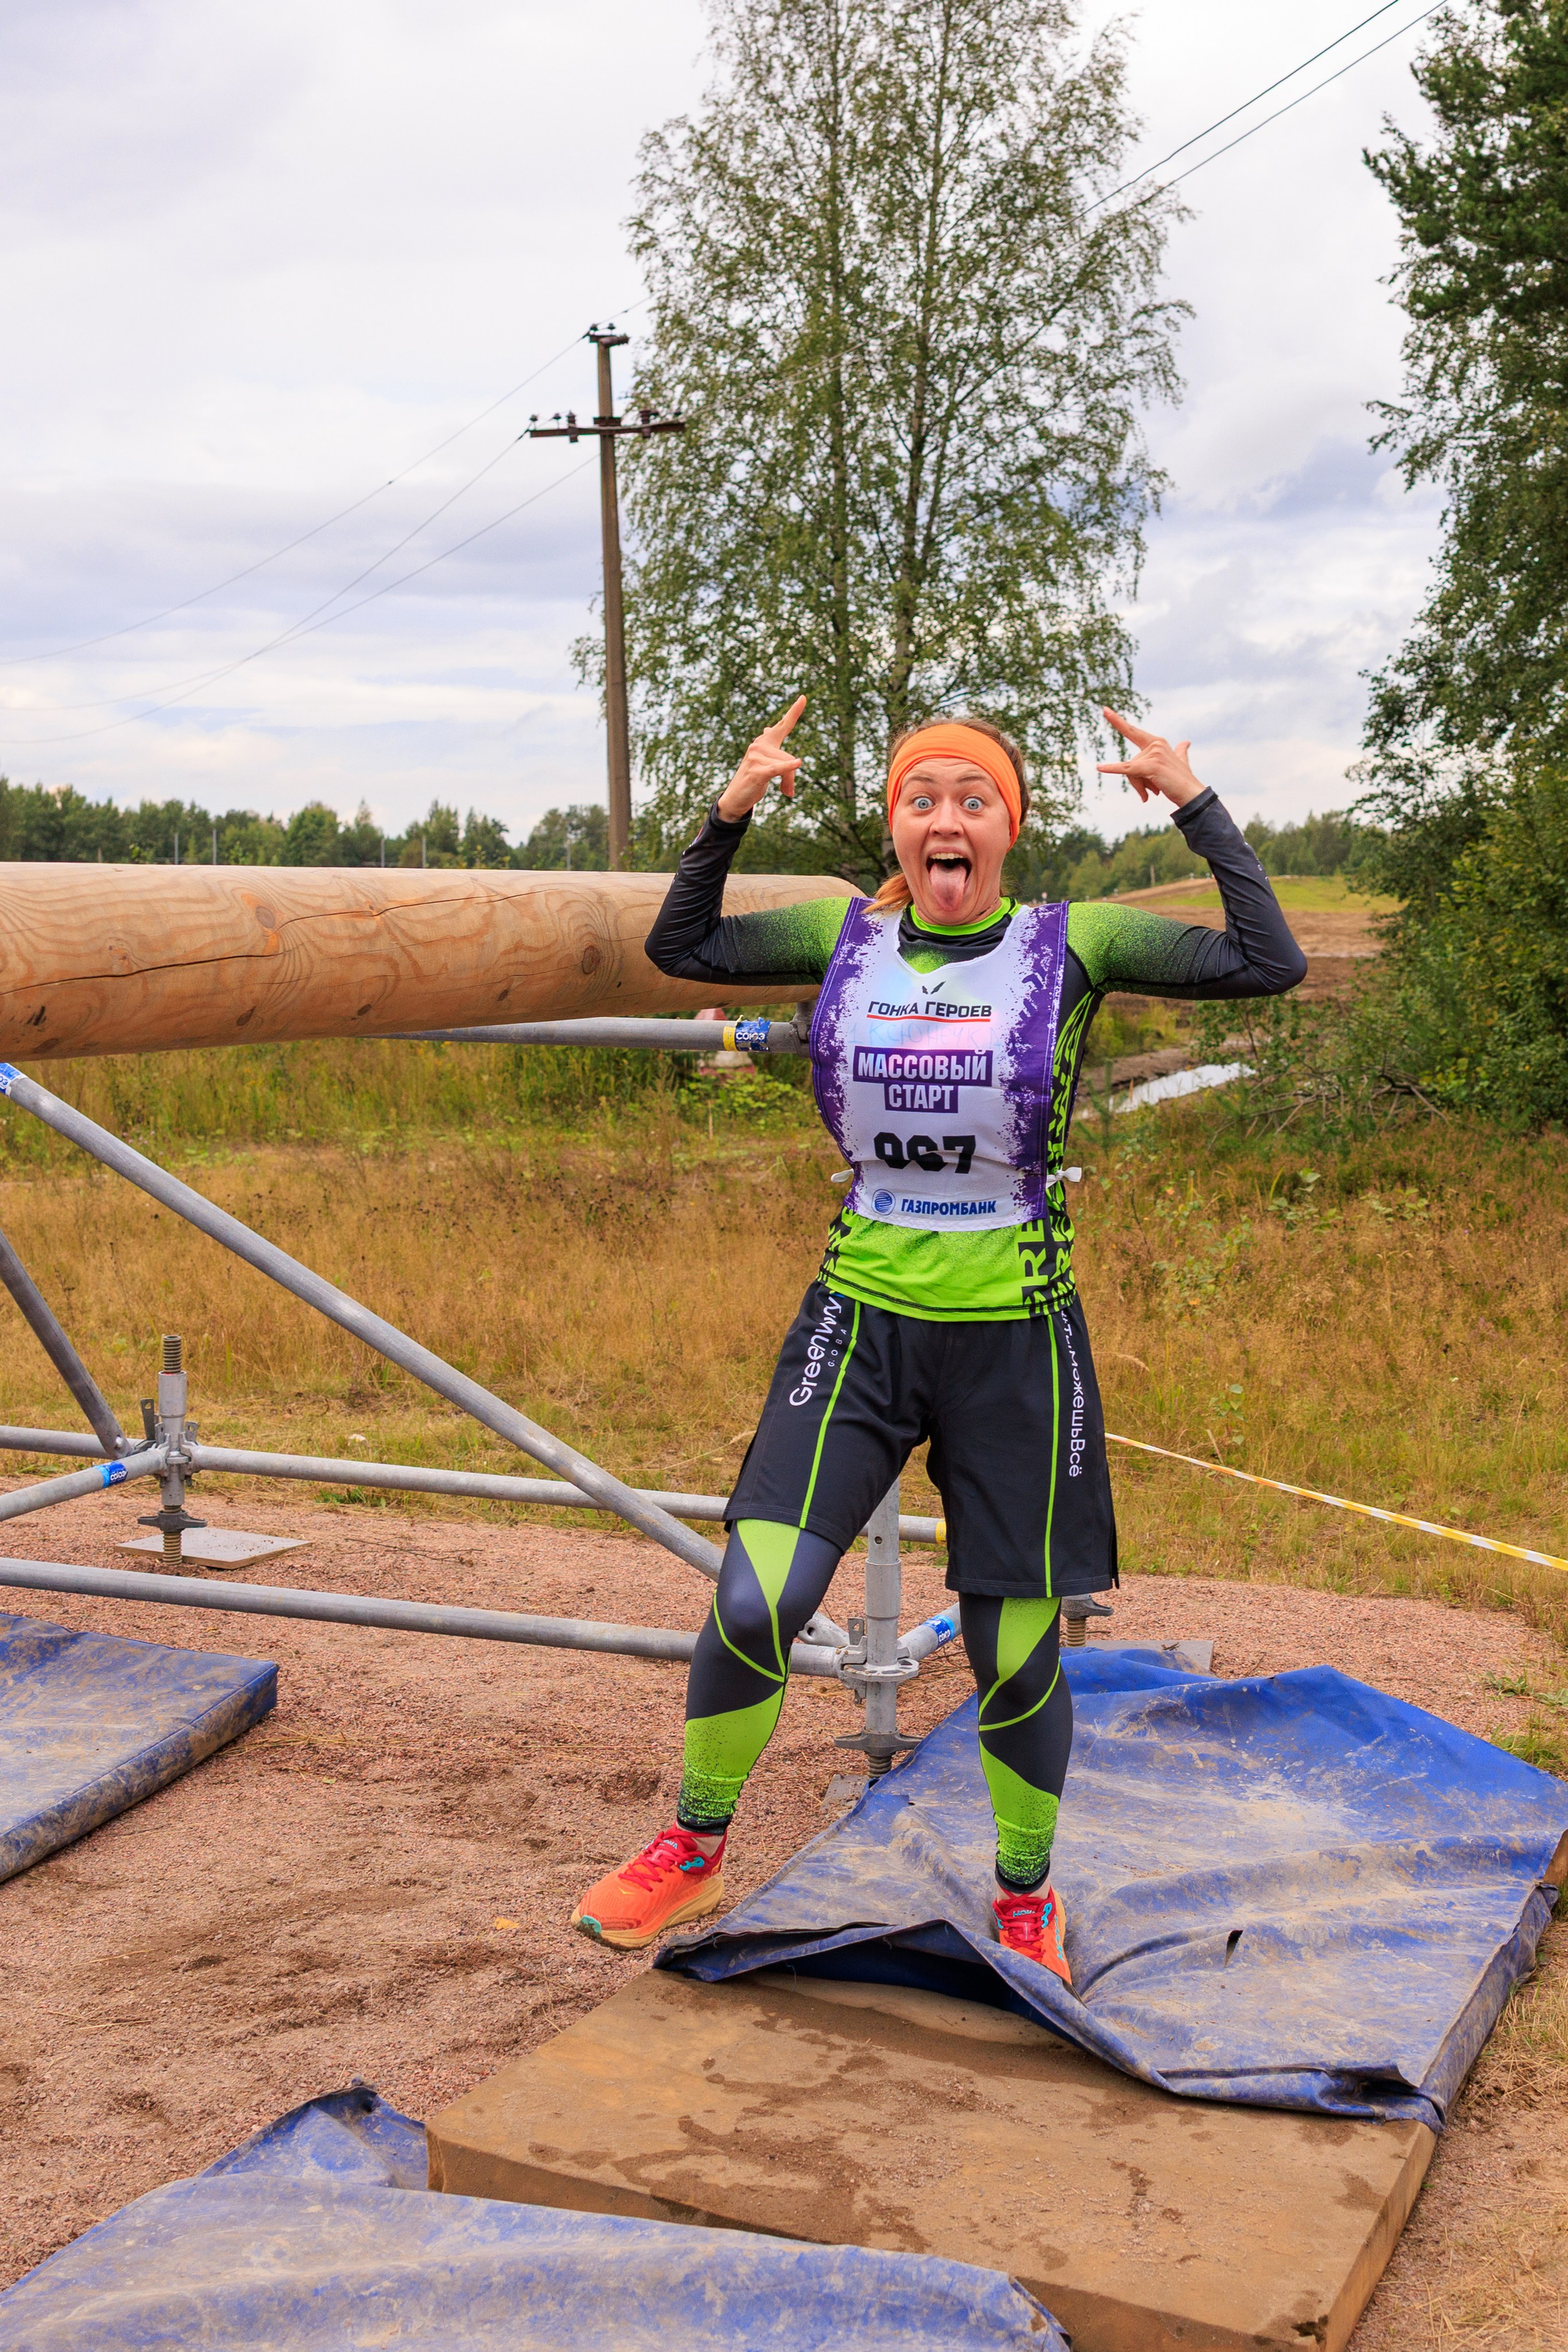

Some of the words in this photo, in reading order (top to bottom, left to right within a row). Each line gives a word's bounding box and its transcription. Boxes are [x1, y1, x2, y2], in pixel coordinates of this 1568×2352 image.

[868, 1001, 918, 1016] ГОНКА
[925, 1001, 992, 1018] ГЕРОЕВ
[858, 1049, 987, 1080] МАССОВЫЙ
[888, 1084, 954, 1109] СТАРТ
[901, 1199, 997, 1215] ГАЗПРОМБАНК
